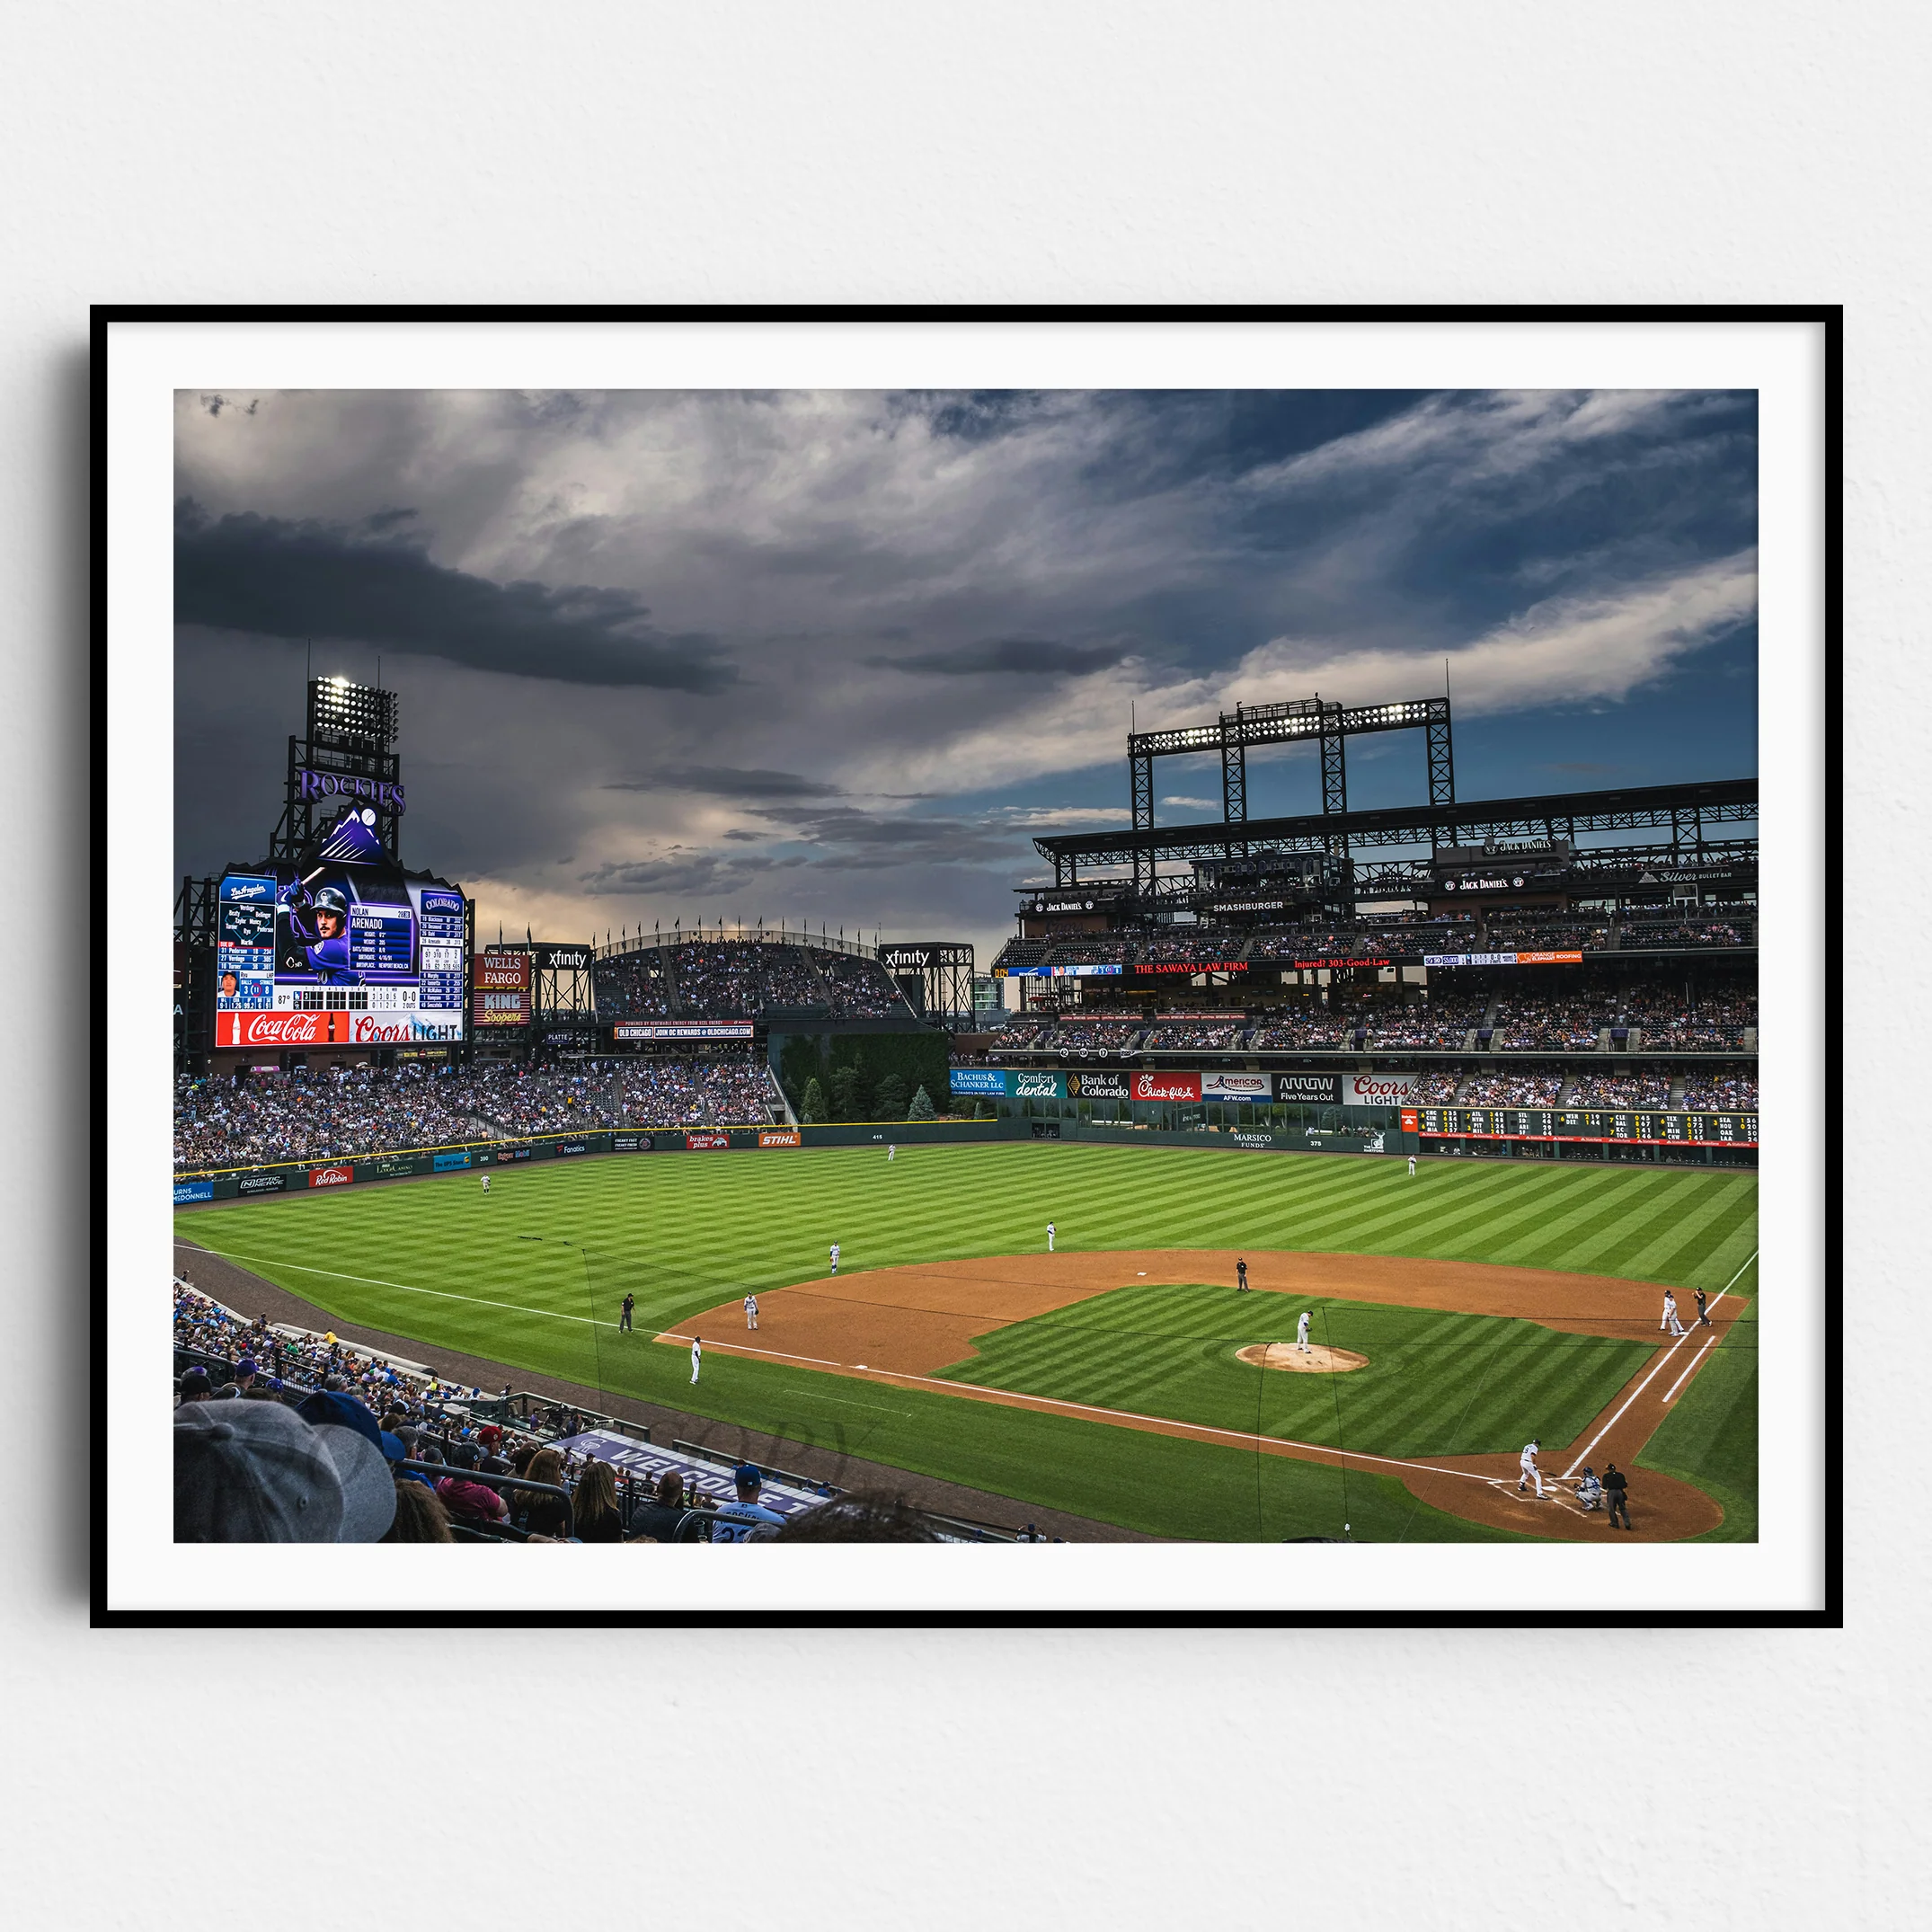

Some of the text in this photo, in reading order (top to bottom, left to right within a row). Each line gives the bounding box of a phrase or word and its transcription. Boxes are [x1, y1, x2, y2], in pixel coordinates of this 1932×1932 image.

[300, 769, 406, 814] ROCKIES
[1500, 841, 1520, 851] JACK
[1660, 871, 1698, 883] Silver
[1460, 880, 1479, 890] JACK
[426, 897, 460, 912] COLORADO
[1046, 903, 1060, 912] JACK
[1214, 902, 1283, 912] SMASHBURGER
[352, 908, 369, 916] NOLAN
[351, 917, 382, 930] ARENADO
[483, 957, 521, 970] WELLS
[549, 949, 586, 969] xfinity
[885, 949, 930, 967] xfinity
[1294, 958, 1390, 969] Injured? 303-Good-Law
[1134, 962, 1248, 974] THE SAWAYA LAW FIRM
[484, 972, 521, 984] FARGO
[403, 991, 416, 1002] 0-0
[484, 994, 520, 1009] KING
[483, 1009, 521, 1025] Soopers
[248, 1013, 320, 1041] Coca-Cola
[355, 1015, 458, 1042] Coors LIGHT
[619, 1028, 651, 1037] OLD CHICAGO
[957, 1072, 996, 1081] BACHUS &
[1018, 1072, 1054, 1084] Comfort
[1081, 1074, 1119, 1086] Bank of
[1212, 1076, 1263, 1087] American
[951, 1079, 989, 1088] SCHANKER
[1016, 1082, 1057, 1097] dental
[1138, 1079, 1194, 1099] Chick-fil-A
[1353, 1075, 1409, 1095] Coors
[1081, 1086, 1128, 1097] Colorado
[1297, 1093, 1318, 1101] Years
[1319, 1093, 1334, 1101] Out
[1364, 1095, 1399, 1105] LIGHT
[762, 1135, 796, 1145] STIHL
[1234, 1134, 1272, 1143] MARSICO
[564, 1145, 585, 1153] Fanatics
[316, 1174, 347, 1185] Red Robin
[610, 1449, 783, 1504] WELCOME
